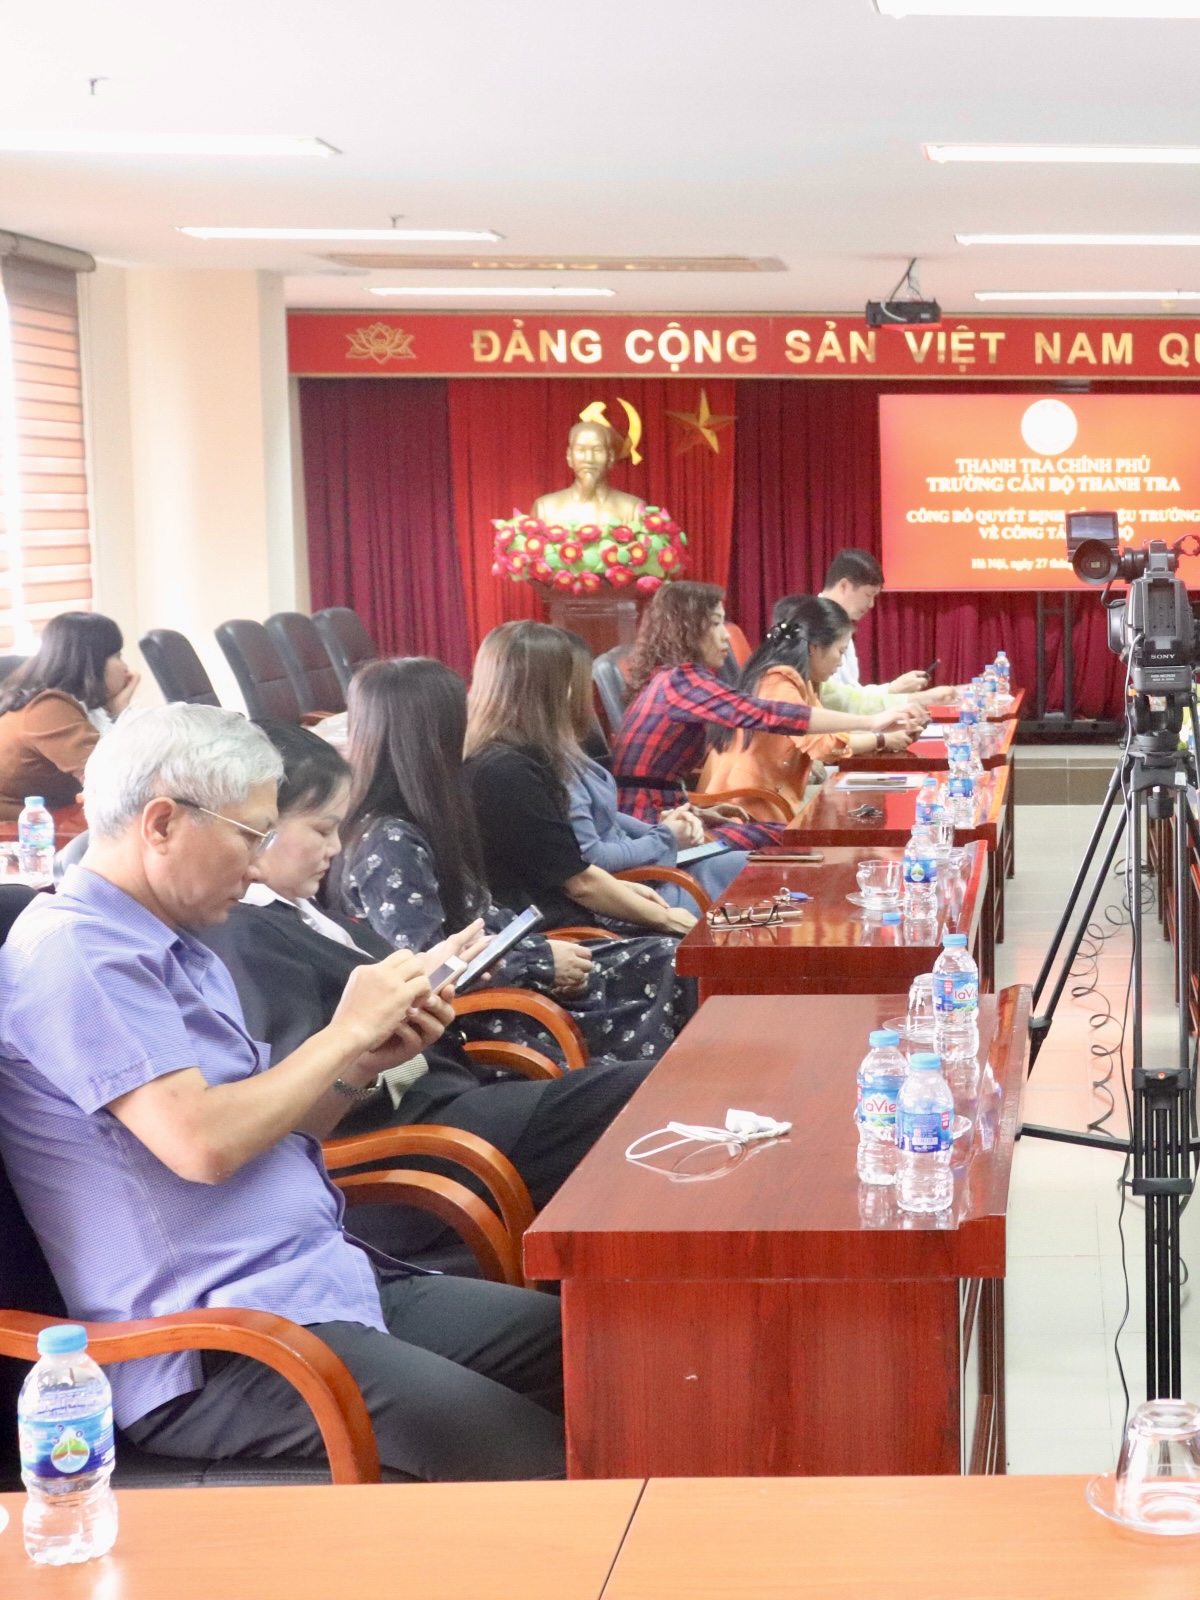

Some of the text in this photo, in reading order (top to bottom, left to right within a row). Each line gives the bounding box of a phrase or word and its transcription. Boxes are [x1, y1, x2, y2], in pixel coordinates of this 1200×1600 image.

[470, 319, 603, 364] ĐẢNG
[624, 322, 758, 372] CỘNG
[785, 321, 876, 364] SẢN
[904, 325, 1006, 373] VIỆT
[1034, 332, 1134, 365] NAM
[955, 454, 1151, 474] THANH TRA CHÍNH PHỦ
[926, 473, 1005, 493] TRƯỜNG
[1048, 474, 1075, 496] BỘ
[1077, 476, 1141, 492] THANH
[1143, 476, 1181, 492] TRA
[906, 507, 950, 523] CÔNG
[975, 507, 1026, 525] QUYẾT
[1000, 524, 1045, 540] CÔNG
[1046, 525, 1067, 540] TÁ
[1035, 557, 1049, 570] 27
